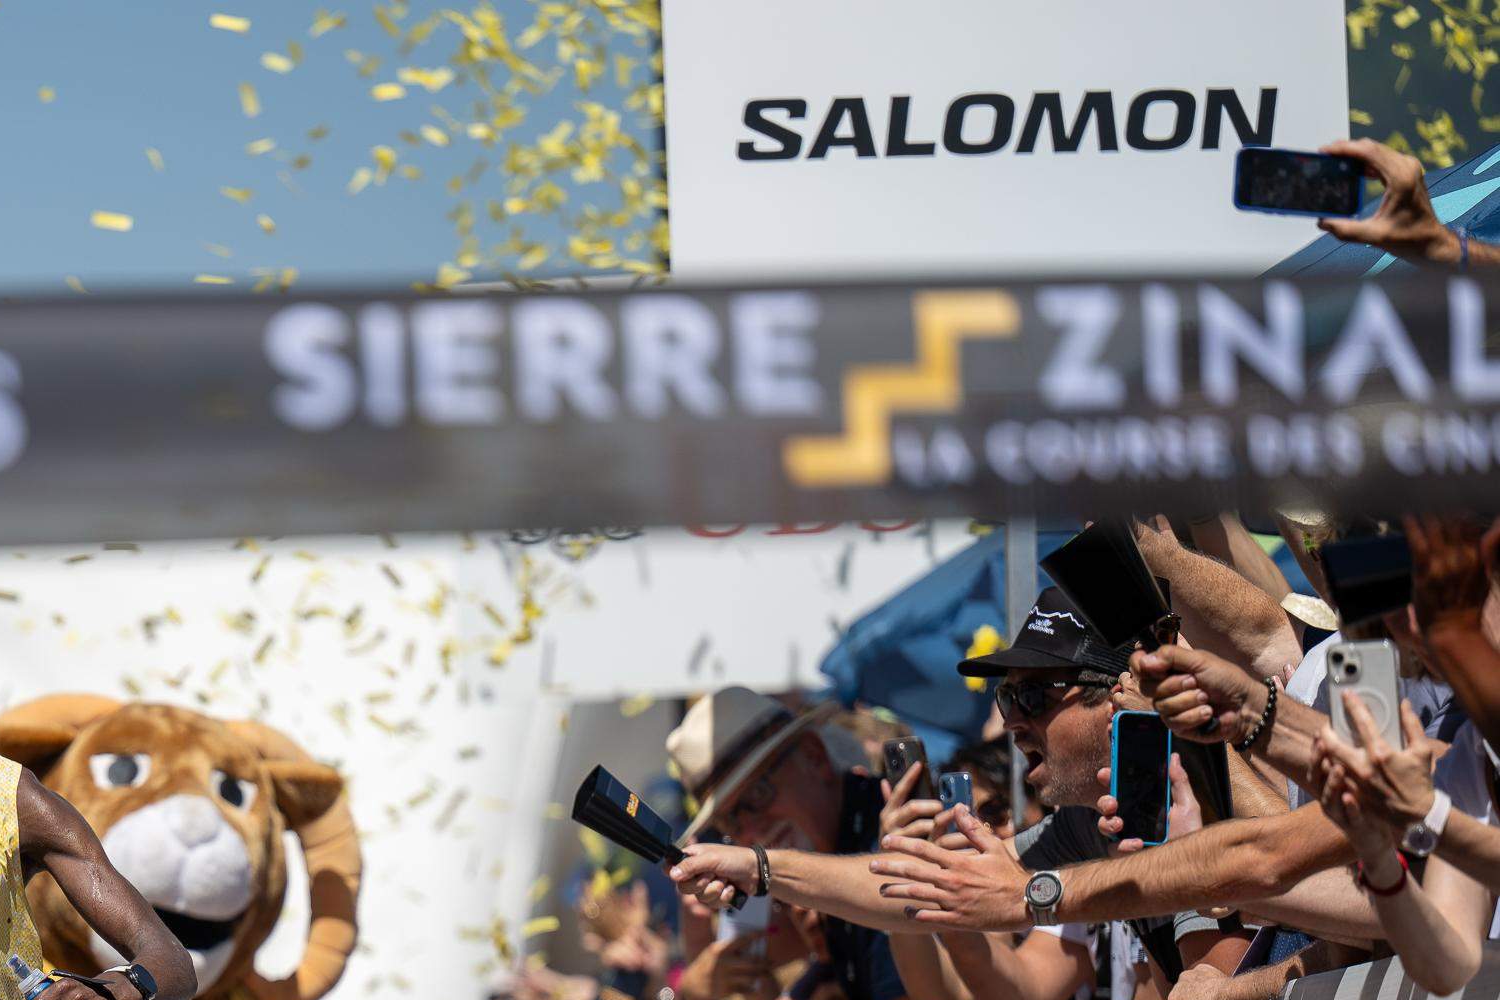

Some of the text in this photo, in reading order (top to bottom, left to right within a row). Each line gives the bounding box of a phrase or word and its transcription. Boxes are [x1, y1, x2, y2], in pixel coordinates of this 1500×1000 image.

[737, 87, 1277, 161] SALOMON
[264, 278, 1500, 430] SIERRE ZINAL
[985, 415, 1232, 484] COURSE
[1247, 411, 1362, 477] DES
[1382, 408, 1500, 476] CIN
